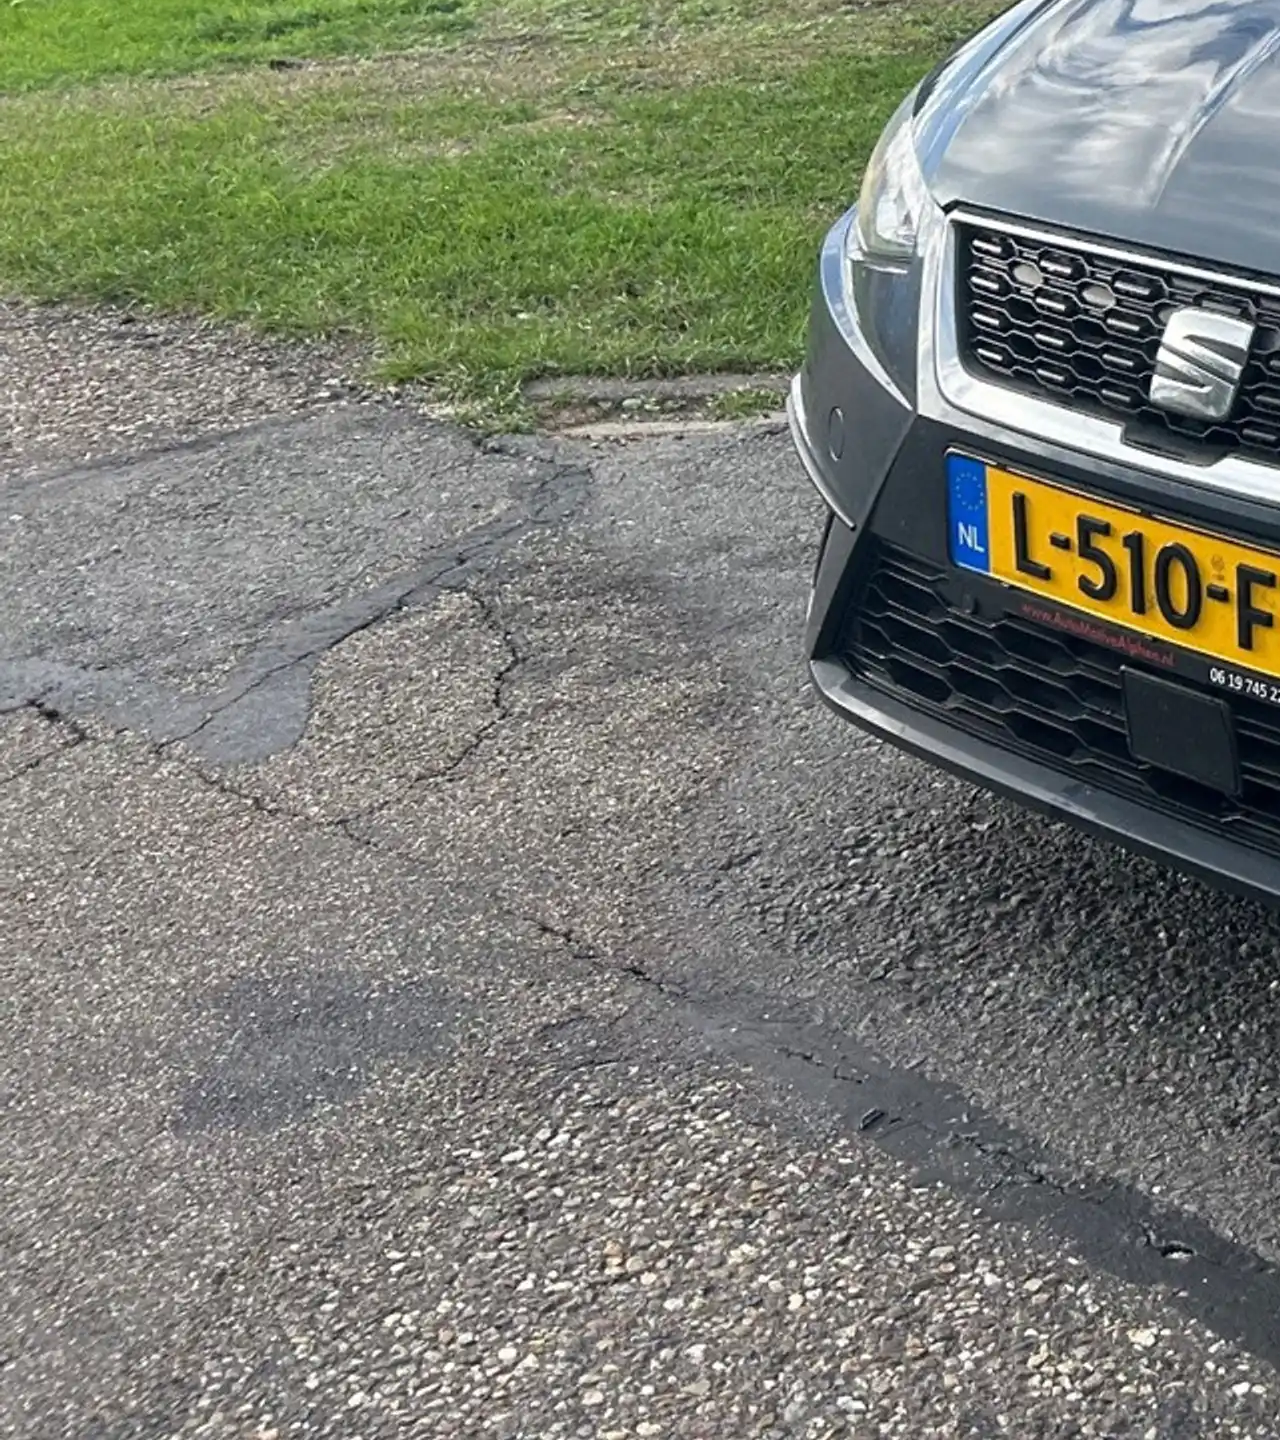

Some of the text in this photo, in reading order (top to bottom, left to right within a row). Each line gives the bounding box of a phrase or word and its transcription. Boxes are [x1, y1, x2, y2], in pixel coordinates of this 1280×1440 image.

[957, 521, 985, 554] NL
[1209, 666, 1226, 685] 06
[1227, 673, 1244, 690] 19
[1244, 678, 1268, 699] 745
